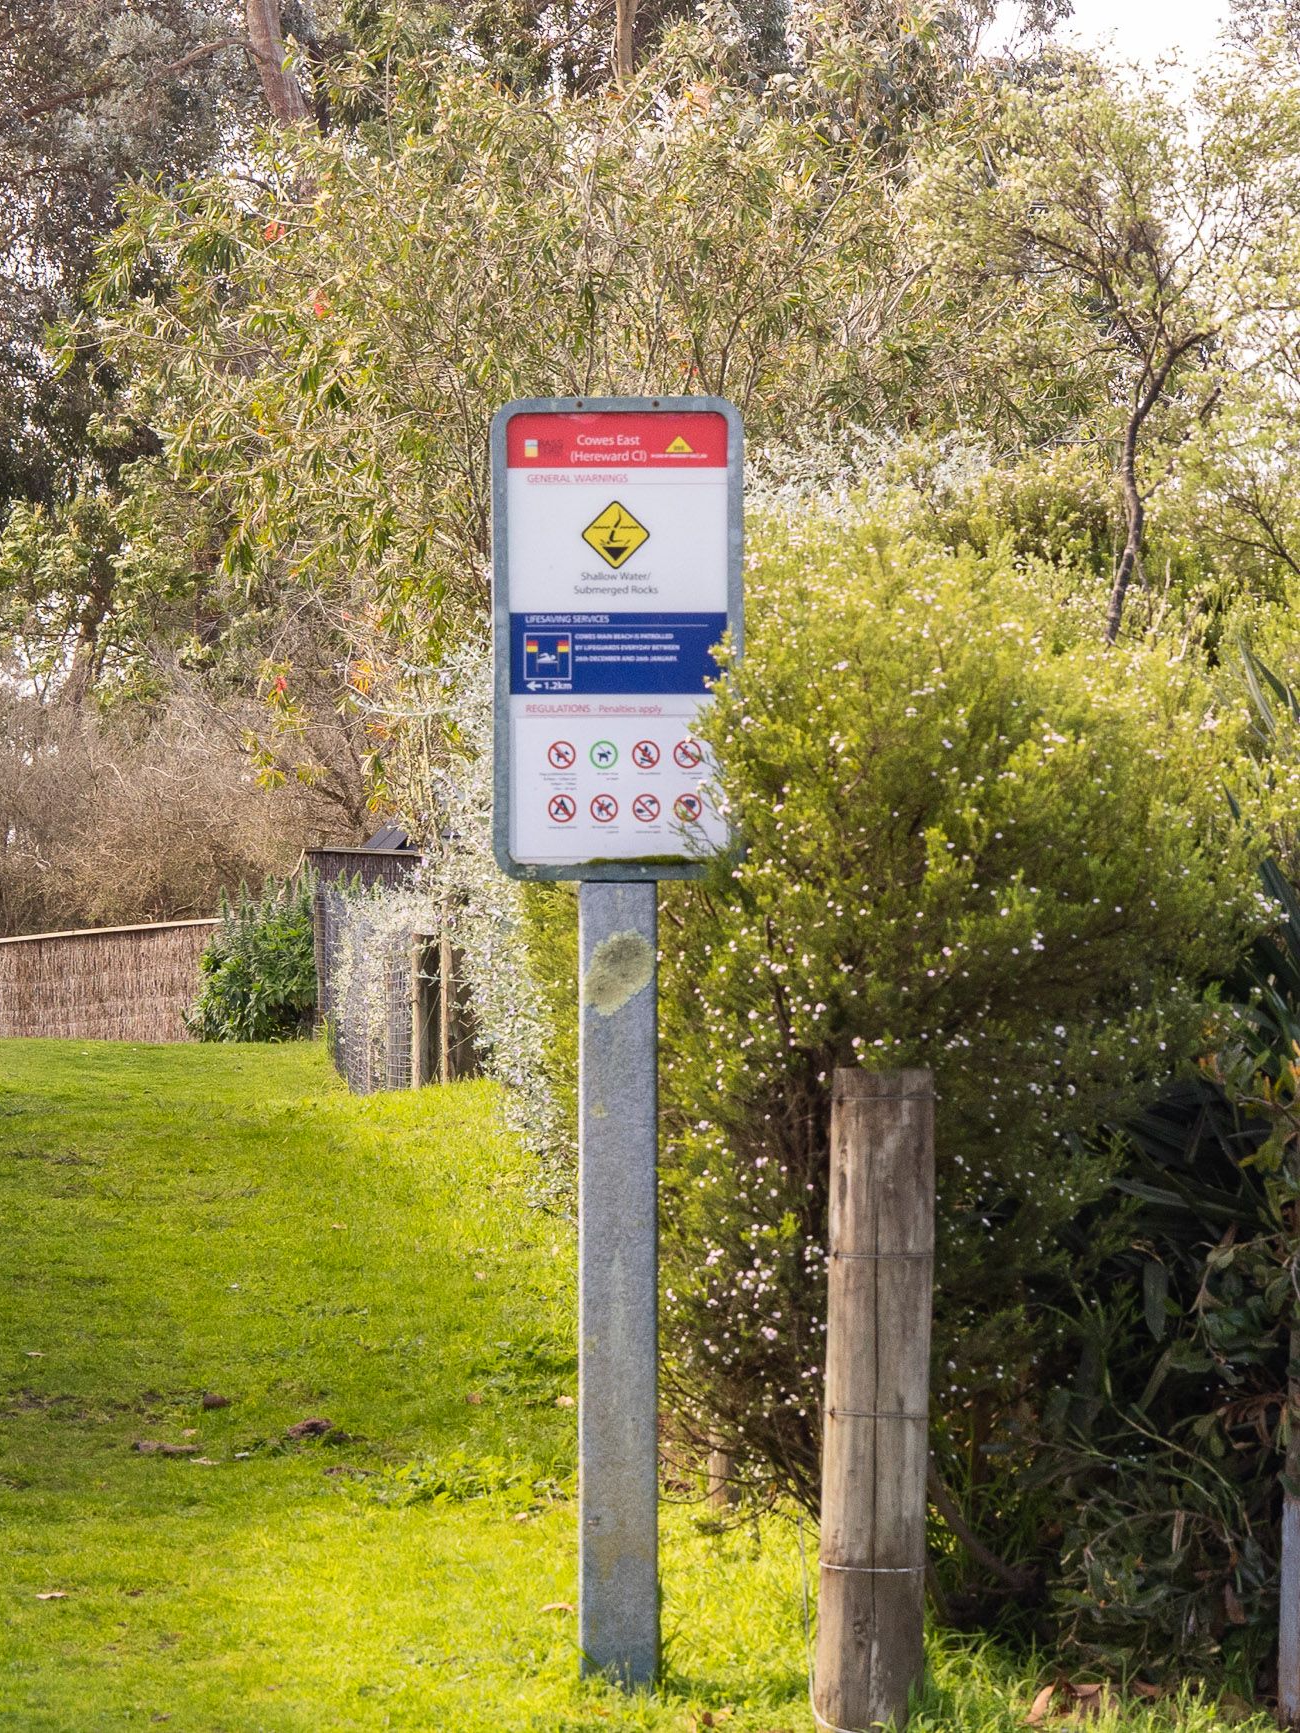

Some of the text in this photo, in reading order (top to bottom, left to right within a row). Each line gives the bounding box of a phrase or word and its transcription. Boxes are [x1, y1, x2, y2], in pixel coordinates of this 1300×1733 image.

[576, 434, 641, 446] Cowes East
[570, 450, 648, 463] (Hereward Cl)
[527, 474, 629, 483] GENERAL WARNINGS
[580, 571, 651, 581] Shallow Water/
[574, 585, 659, 596] Submerged Rocks
[525, 615, 610, 624] LIFESAVING SERVICES
[543, 681, 573, 690] 1.2km
[525, 704, 661, 714] REGULATIONS Penalties apply
